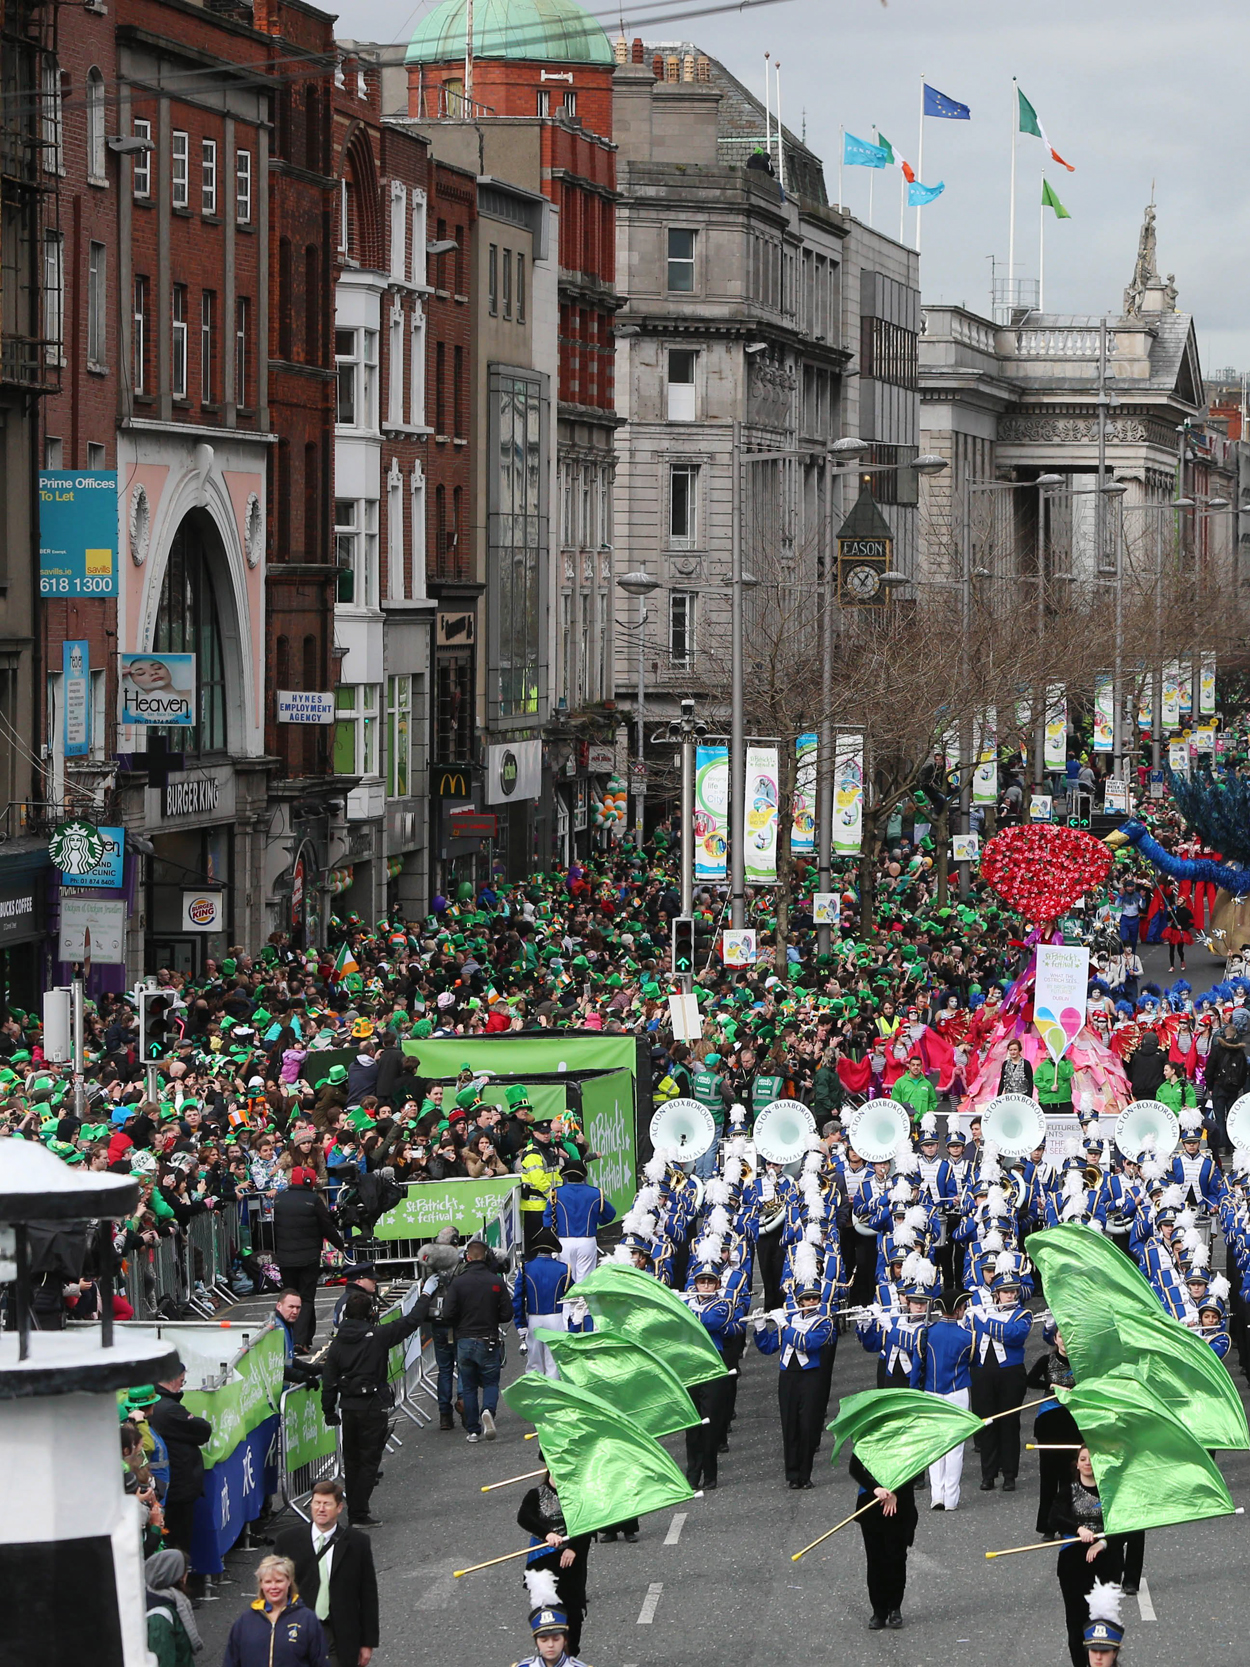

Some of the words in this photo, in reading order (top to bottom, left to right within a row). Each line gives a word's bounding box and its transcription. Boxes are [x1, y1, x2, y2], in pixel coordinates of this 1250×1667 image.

[39, 477, 73, 489] Prime
[75, 477, 115, 489] Offices
[39, 490, 53, 501] To
[56, 491, 74, 501] Let
[843, 541, 883, 556] EASON
[40, 567, 72, 576] savills.ie
[87, 565, 111, 574] savills
[40, 577, 69, 592] 618
[73, 577, 112, 592] 1300
[123, 687, 190, 719] Heaven
[292, 694, 323, 704] HYNES
[279, 703, 332, 713] EMPLOYMENT
[289, 712, 322, 722] AGENCY
[166, 782, 198, 816] BURGER
[199, 778, 219, 811] KING
[706, 794, 724, 805] City
[92, 869, 116, 877] CLINIC
[15, 896, 33, 915] COFFEE
[192, 902, 214, 912] BURGER
[192, 907, 214, 919] KING
[651, 1099, 713, 1138] ACTON-BOXBOROUGH
[755, 1101, 815, 1136] ACTON-BOXBOROUG
[851, 1100, 909, 1137] ACTON-BOXBOROUGH
[983, 1094, 1045, 1132] ACTON-BOXBOROUGH
[1116, 1102, 1178, 1138] ACTON-BOXBOROUGH
[857, 1147, 898, 1161] COLONIAL
[1000, 1145, 1033, 1157] LONIALS
